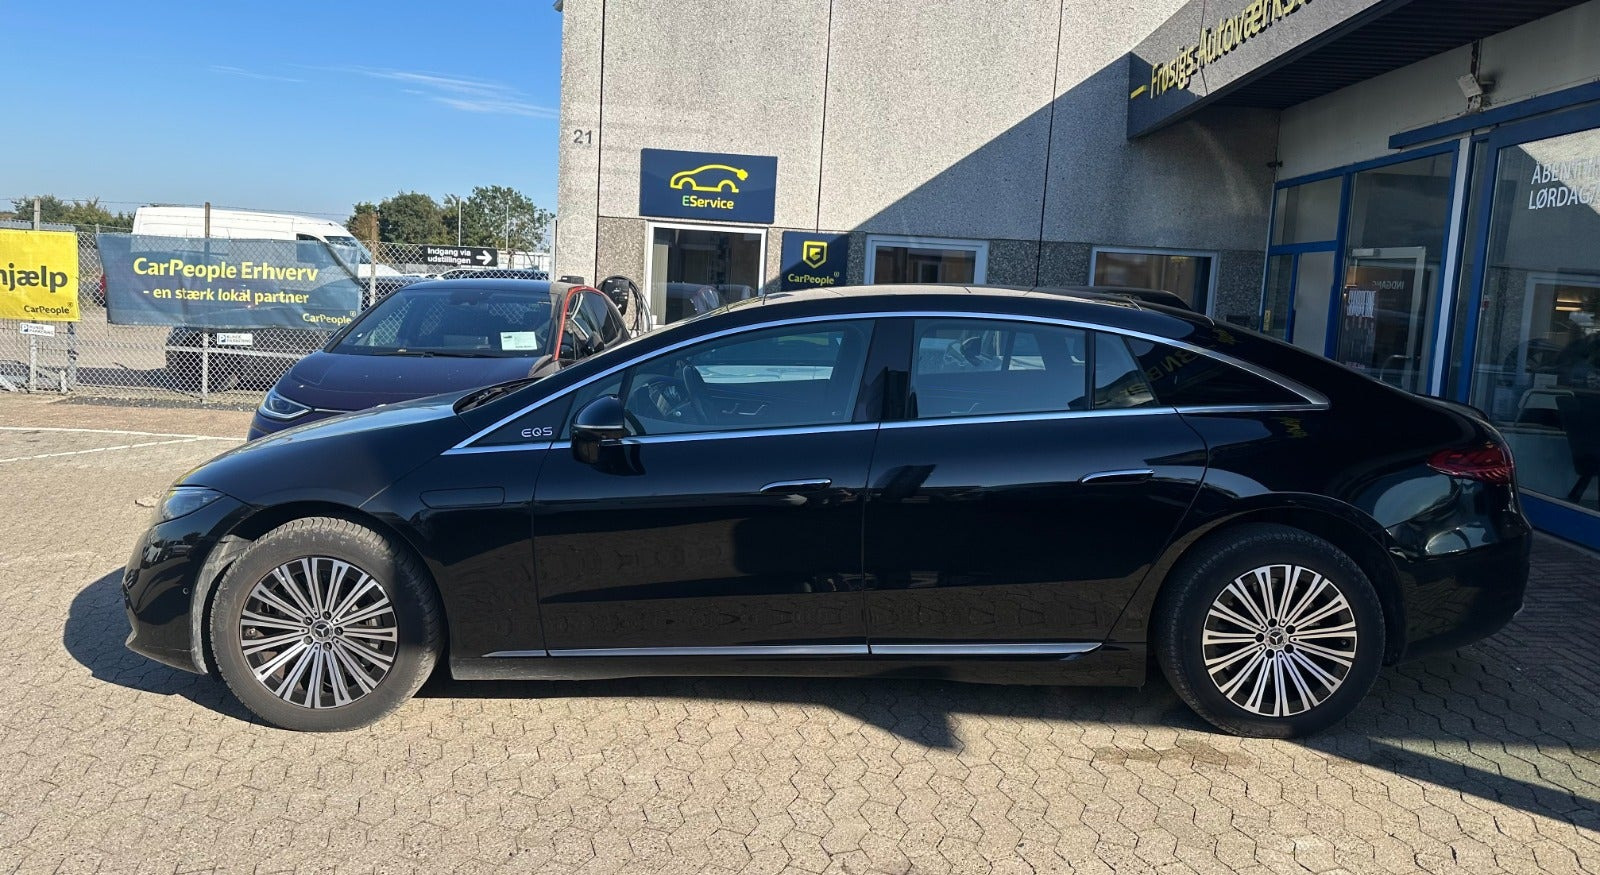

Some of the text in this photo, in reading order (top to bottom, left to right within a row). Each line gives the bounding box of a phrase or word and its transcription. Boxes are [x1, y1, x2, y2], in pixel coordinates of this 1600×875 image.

[573, 129, 593, 145] 21
[682, 195, 735, 210] EService
[427, 247, 459, 257] Indgang
[427, 255, 472, 264] udstillingen
[133, 257, 319, 282] CarPeople Erhverv
[153, 289, 172, 299] en
[175, 287, 215, 301] stærk
[218, 288, 251, 302] lokal
[254, 290, 310, 305] partner
[521, 427, 553, 438] EQS
